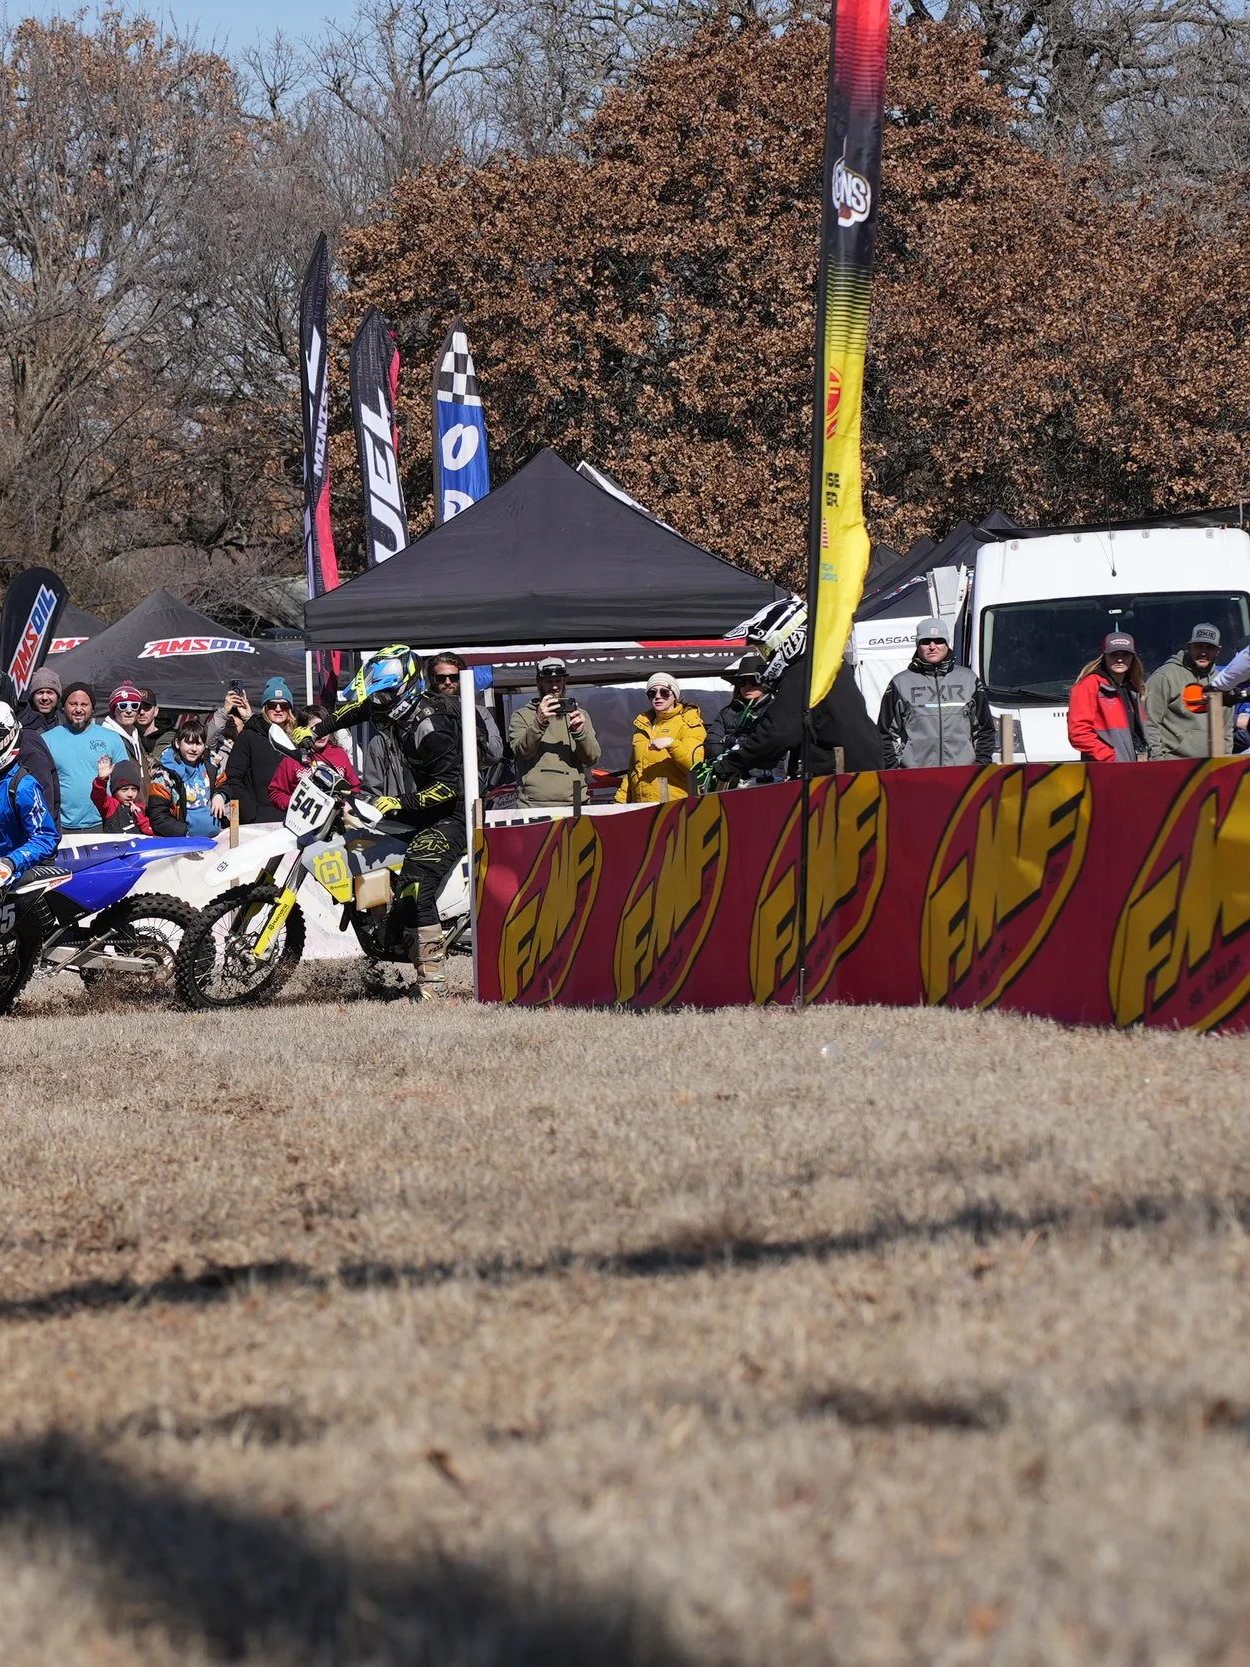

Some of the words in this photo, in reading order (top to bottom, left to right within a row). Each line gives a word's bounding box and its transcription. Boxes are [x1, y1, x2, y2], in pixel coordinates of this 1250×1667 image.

[9, 585, 57, 699] AMSOIL
[140, 637, 255, 657] AMSOIL
[868, 635, 917, 646] GASGAS
[911, 685, 965, 701] FXR
[290, 788, 323, 825] 541
[504, 815, 597, 1003] FMF
[621, 794, 722, 1003] FMF
[927, 763, 1086, 1007] FMF
